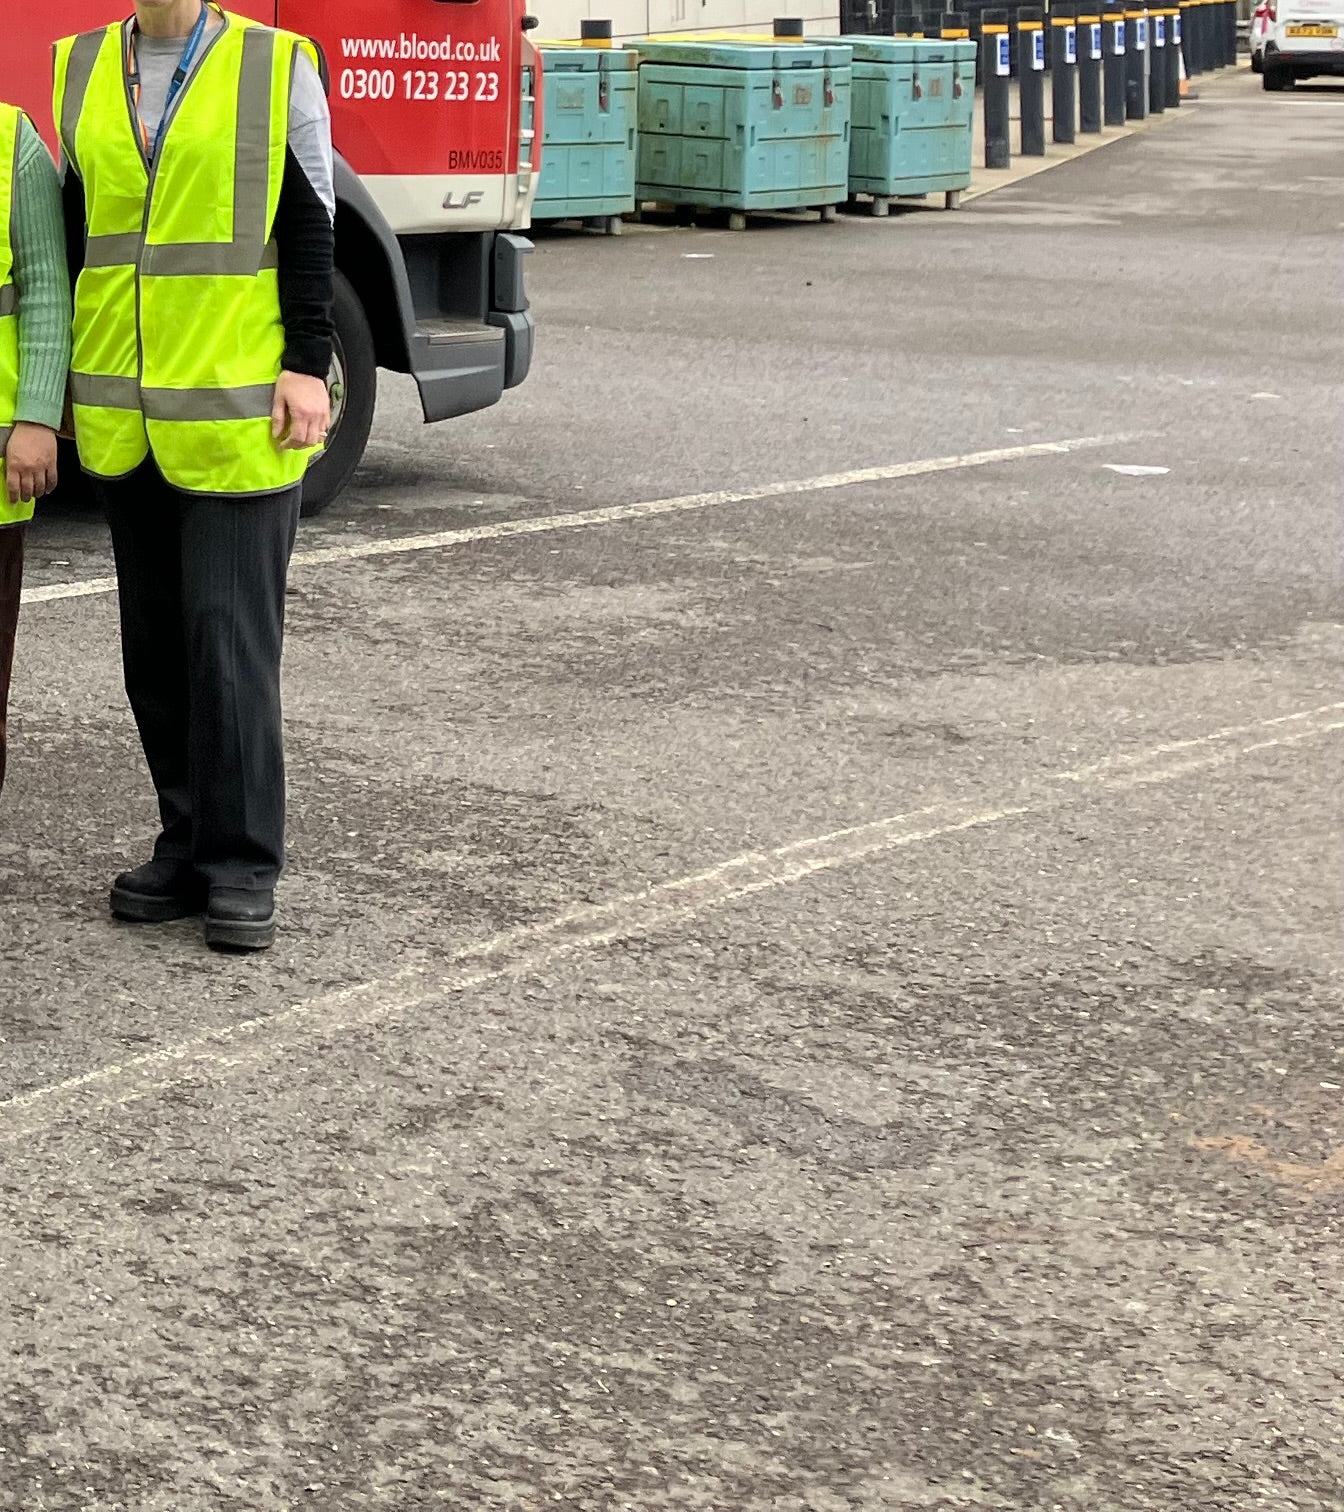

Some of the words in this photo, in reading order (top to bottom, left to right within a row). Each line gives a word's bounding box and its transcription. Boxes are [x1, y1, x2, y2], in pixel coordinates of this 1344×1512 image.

[341, 33, 501, 62] www.blood.co.uk
[340, 69, 394, 99] 0300
[403, 70, 438, 100] 123
[444, 71, 469, 101] 23
[475, 72, 499, 102] 23
[448, 150, 503, 170] BMV035
[442, 191, 485, 209] LF
